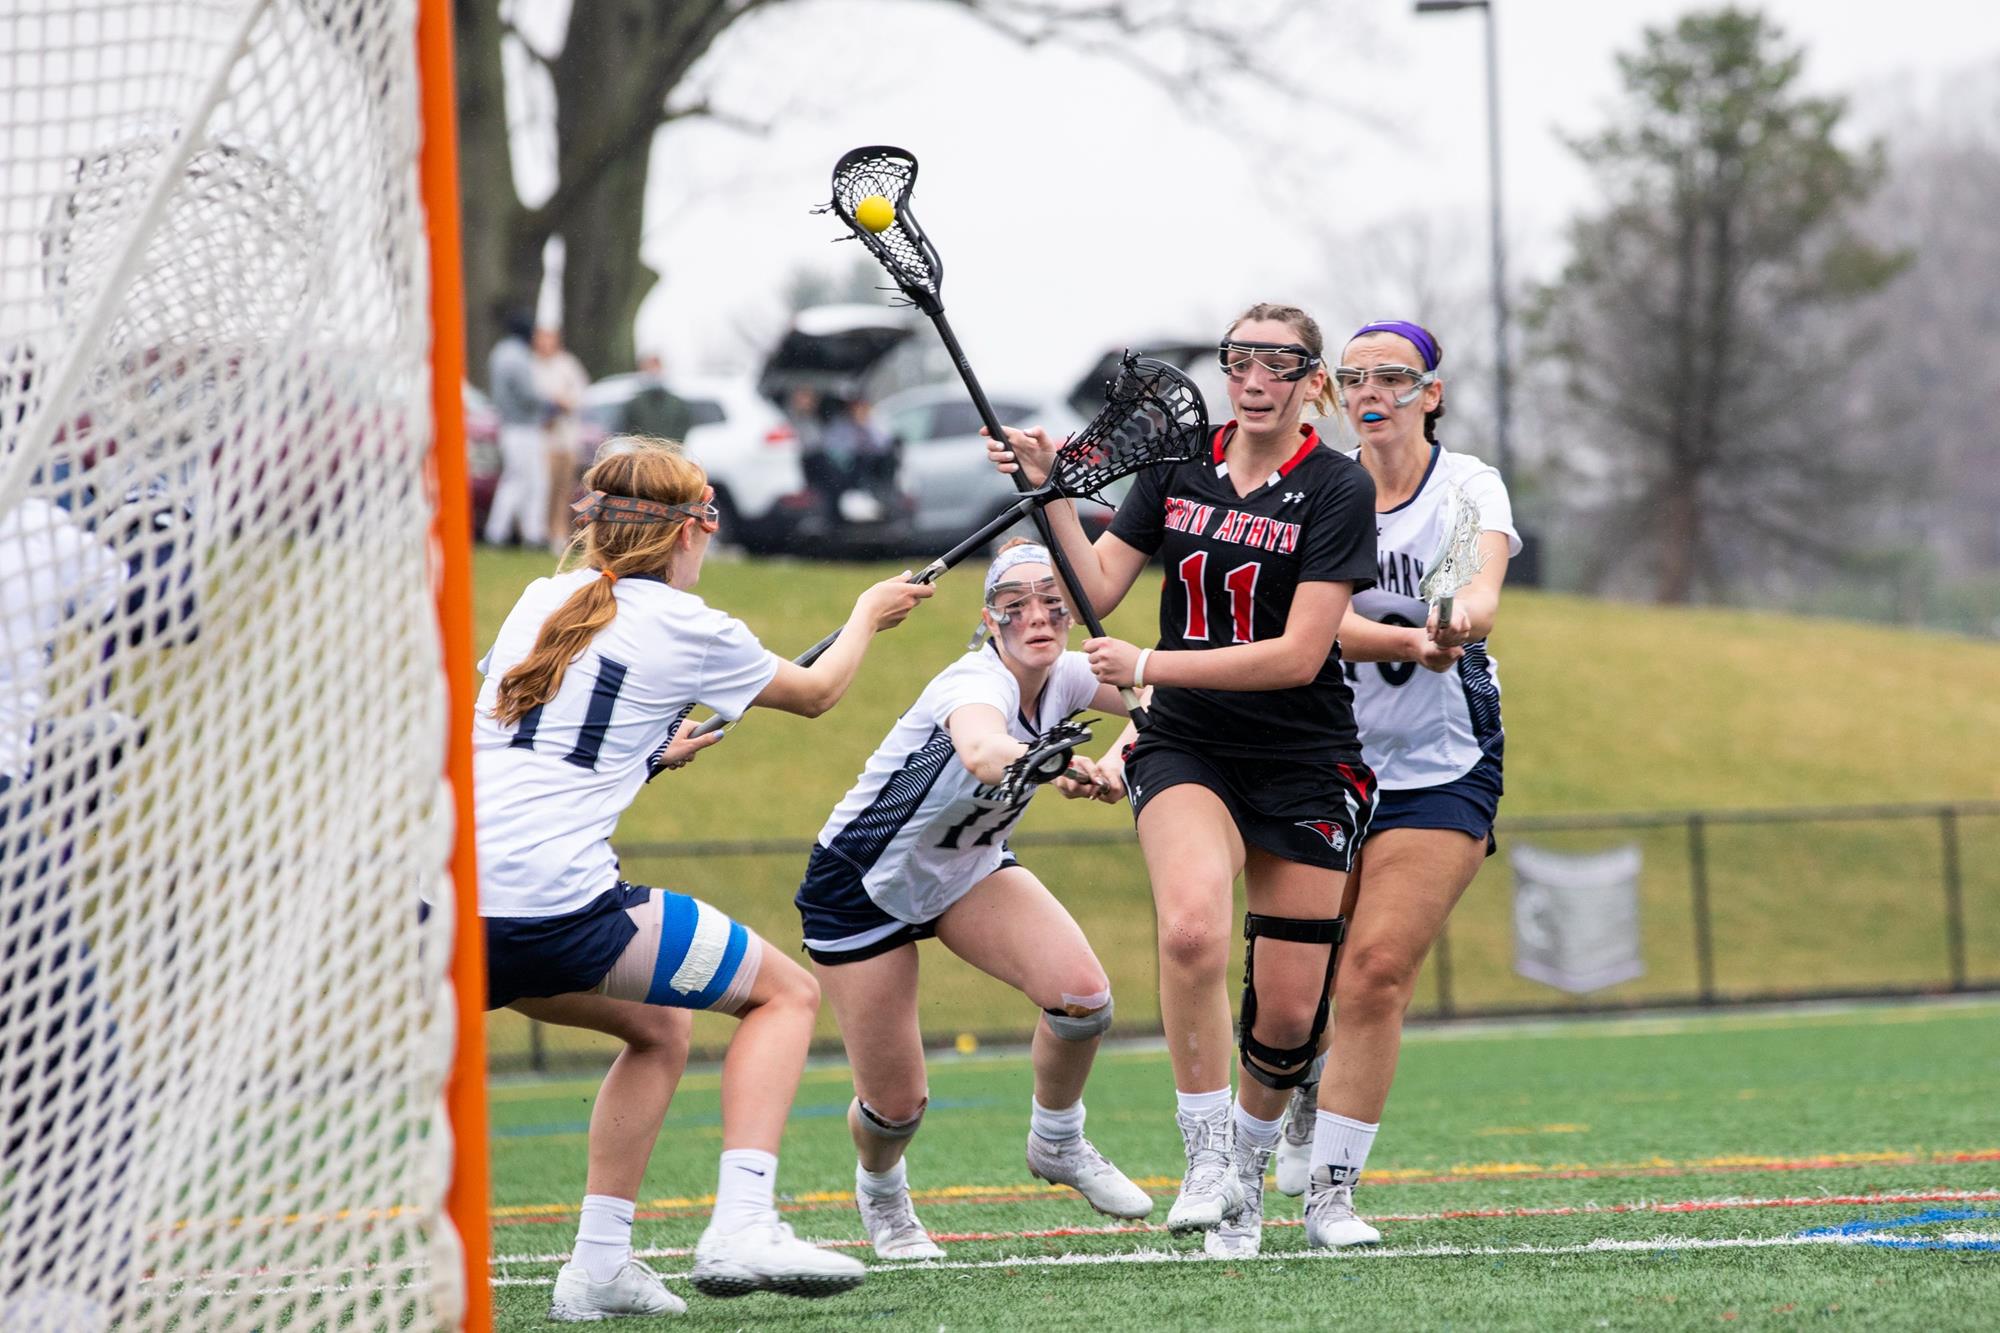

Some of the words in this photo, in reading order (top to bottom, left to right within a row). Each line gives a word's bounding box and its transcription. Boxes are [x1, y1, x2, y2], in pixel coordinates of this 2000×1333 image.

[636, 501, 669, 517] STX
[1212, 509, 1302, 555] ATHYN
[1179, 550, 1262, 643] 11
